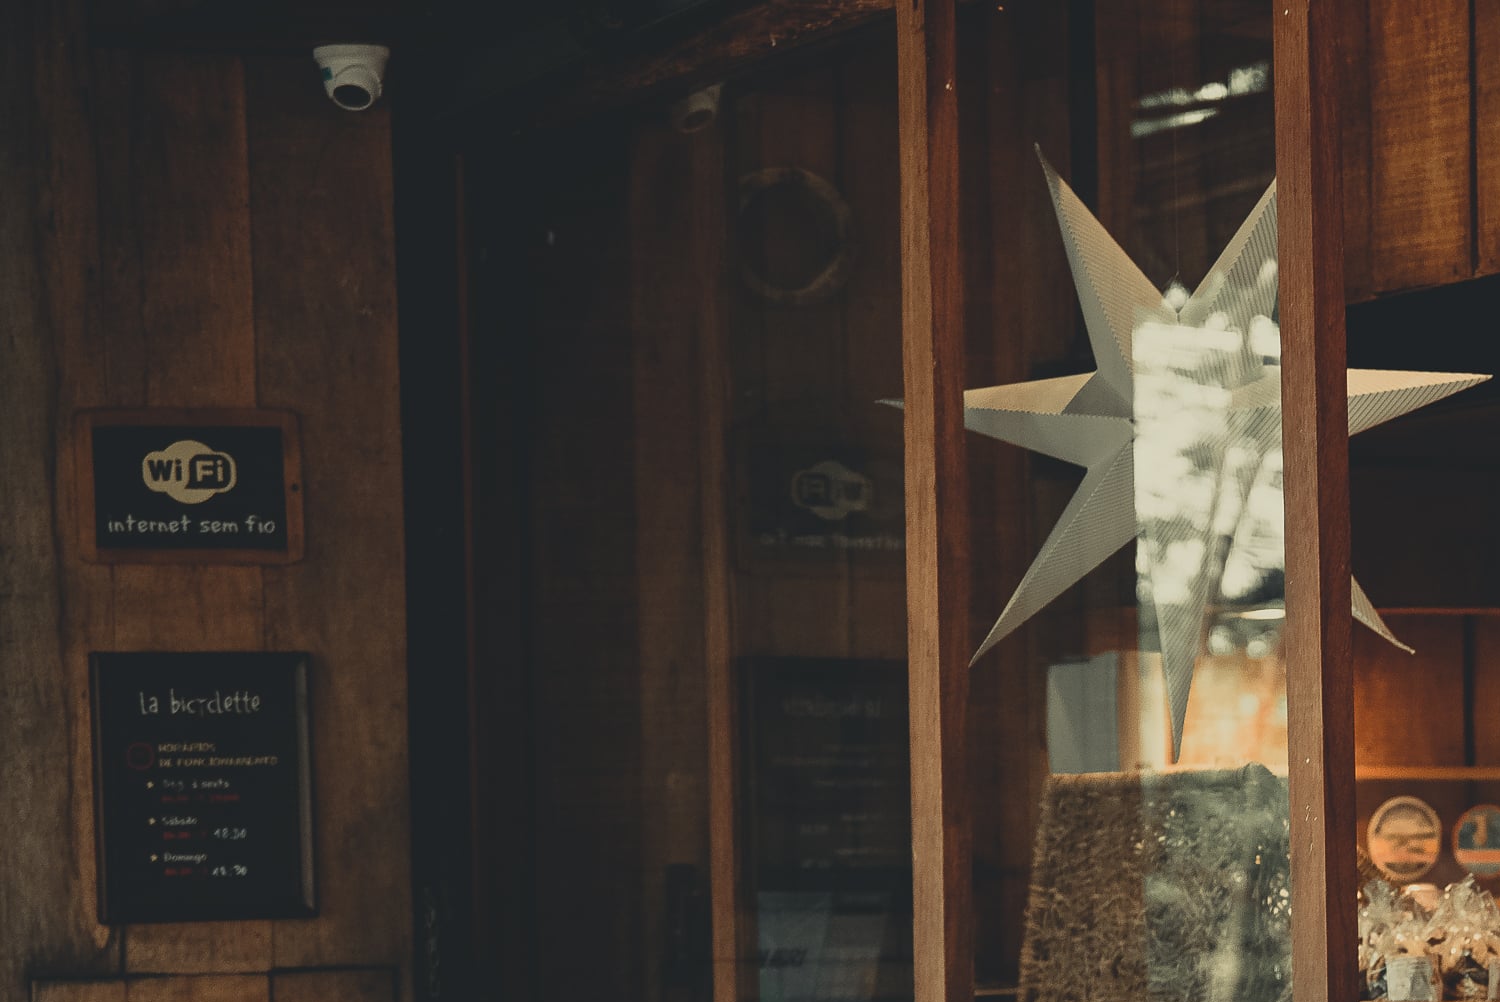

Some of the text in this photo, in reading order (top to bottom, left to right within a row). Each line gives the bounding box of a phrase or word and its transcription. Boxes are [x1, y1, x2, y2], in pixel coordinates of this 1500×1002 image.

[108, 514, 276, 534] internet sem fio
[139, 690, 159, 715] la
